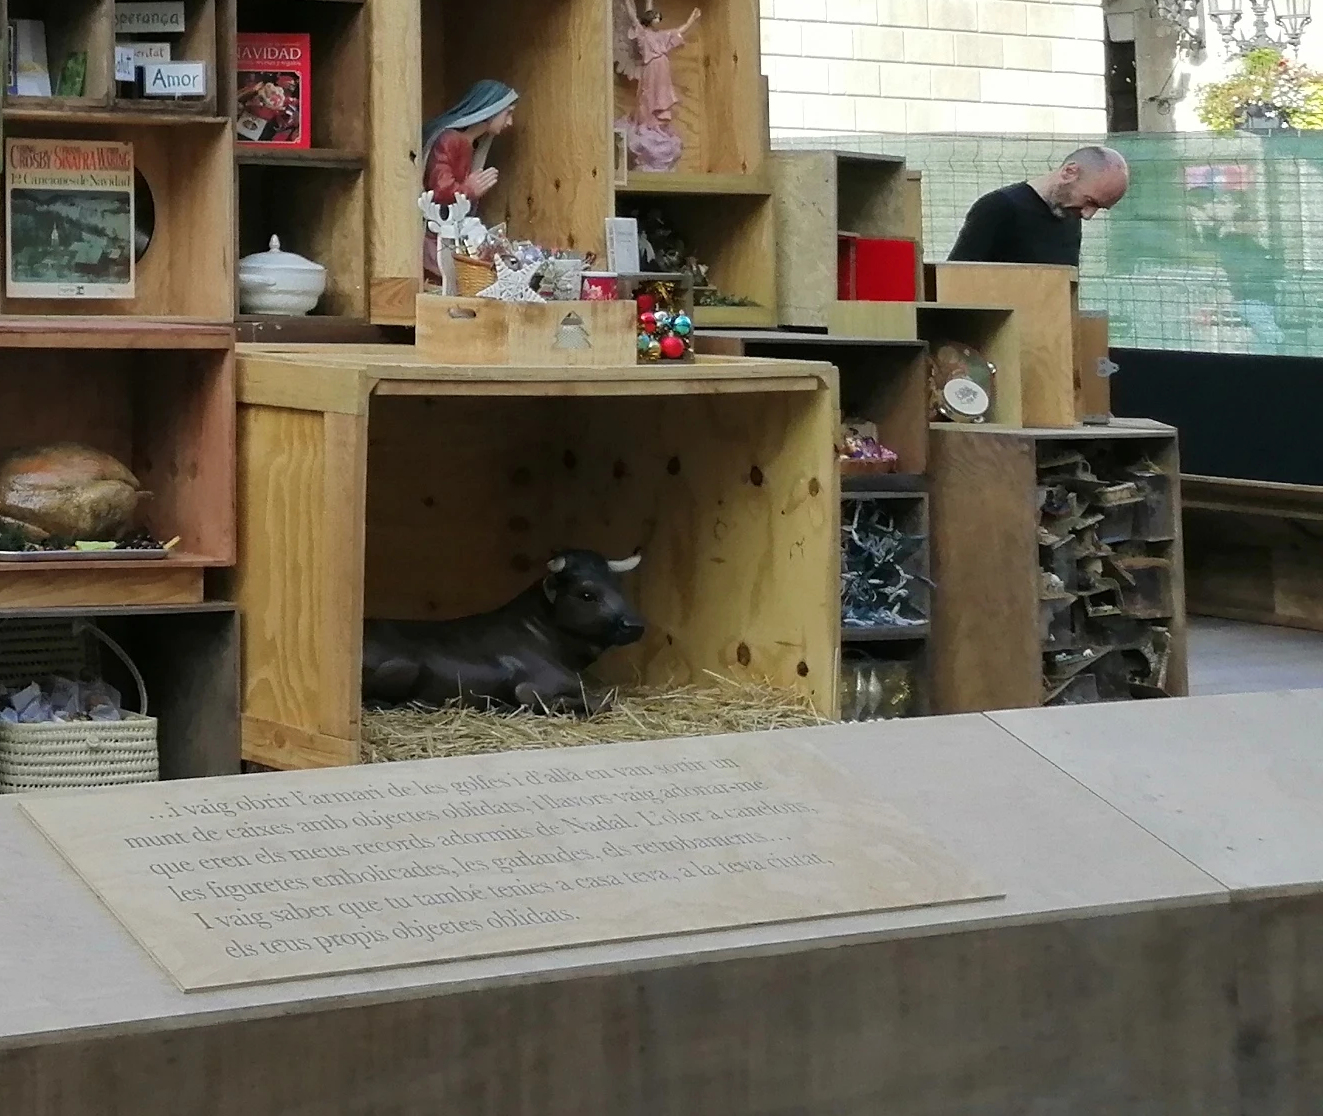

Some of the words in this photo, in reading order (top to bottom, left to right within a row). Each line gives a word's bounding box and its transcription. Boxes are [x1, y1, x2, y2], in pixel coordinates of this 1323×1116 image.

[152, 68, 199, 88] Amor
[10, 145, 52, 170] CROSBY
[90, 174, 131, 187] Navidad
[124, 832, 189, 849] munt
[192, 826, 223, 843] de
[226, 821, 296, 839] caixes
[296, 814, 348, 833] amb
[352, 807, 440, 830] objectes
[441, 799, 535, 821] oblidats,
[541, 792, 612, 810] llavors
[613, 786, 663, 805] vaig
[658, 777, 770, 801] adonar-me
[183, 798, 237, 819] vaig
[236, 793, 291, 812] obrir
[290, 784, 384, 806] l'armari
[388, 782, 416, 799] de
[412, 780, 448, 795] les
[451, 774, 512, 796] golfes
[586, 766, 613, 781] en
[613, 764, 653, 779] van
[654, 757, 708, 775] sortir
[711, 756, 741, 771] un
[149, 861, 195, 880] que
[198, 854, 252, 871] eren
[255, 847, 287, 865] els
[288, 845, 351, 862] meus
[352, 833, 436, 856] records
[436, 824, 536, 847] adormits
[536, 820, 565, 837] de
[561, 812, 639, 834] Nadal.
[709, 809, 724, 821] a
[168, 885, 207, 903] les
[205, 876, 309, 902] figuretes
[312, 861, 459, 887] embolicades,
[452, 856, 490, 874] les
[491, 845, 603, 874] garlandes,
[602, 841, 633, 858] els
[192, 912, 215, 930] I
[215, 908, 273, 930] vaig
[269, 902, 338, 922] saber
[338, 899, 384, 920] que
[385, 894, 414, 910] tu
[412, 883, 488, 906] també
[488, 878, 555, 899] tenies
[555, 879, 572, 891] a
[575, 873, 624, 889] casa
[622, 867, 680, 884] teva,
[678, 866, 696, 878] a
[691, 860, 718, 876] la
[717, 858, 765, 874] teva
[765, 851, 836, 869] ciutat,
[224, 939, 259, 960] els
[259, 936, 312, 955] teus
[312, 925, 390, 954] propis
[392, 917, 484, 942] objectes
[486, 906, 581, 930] oblidats.
